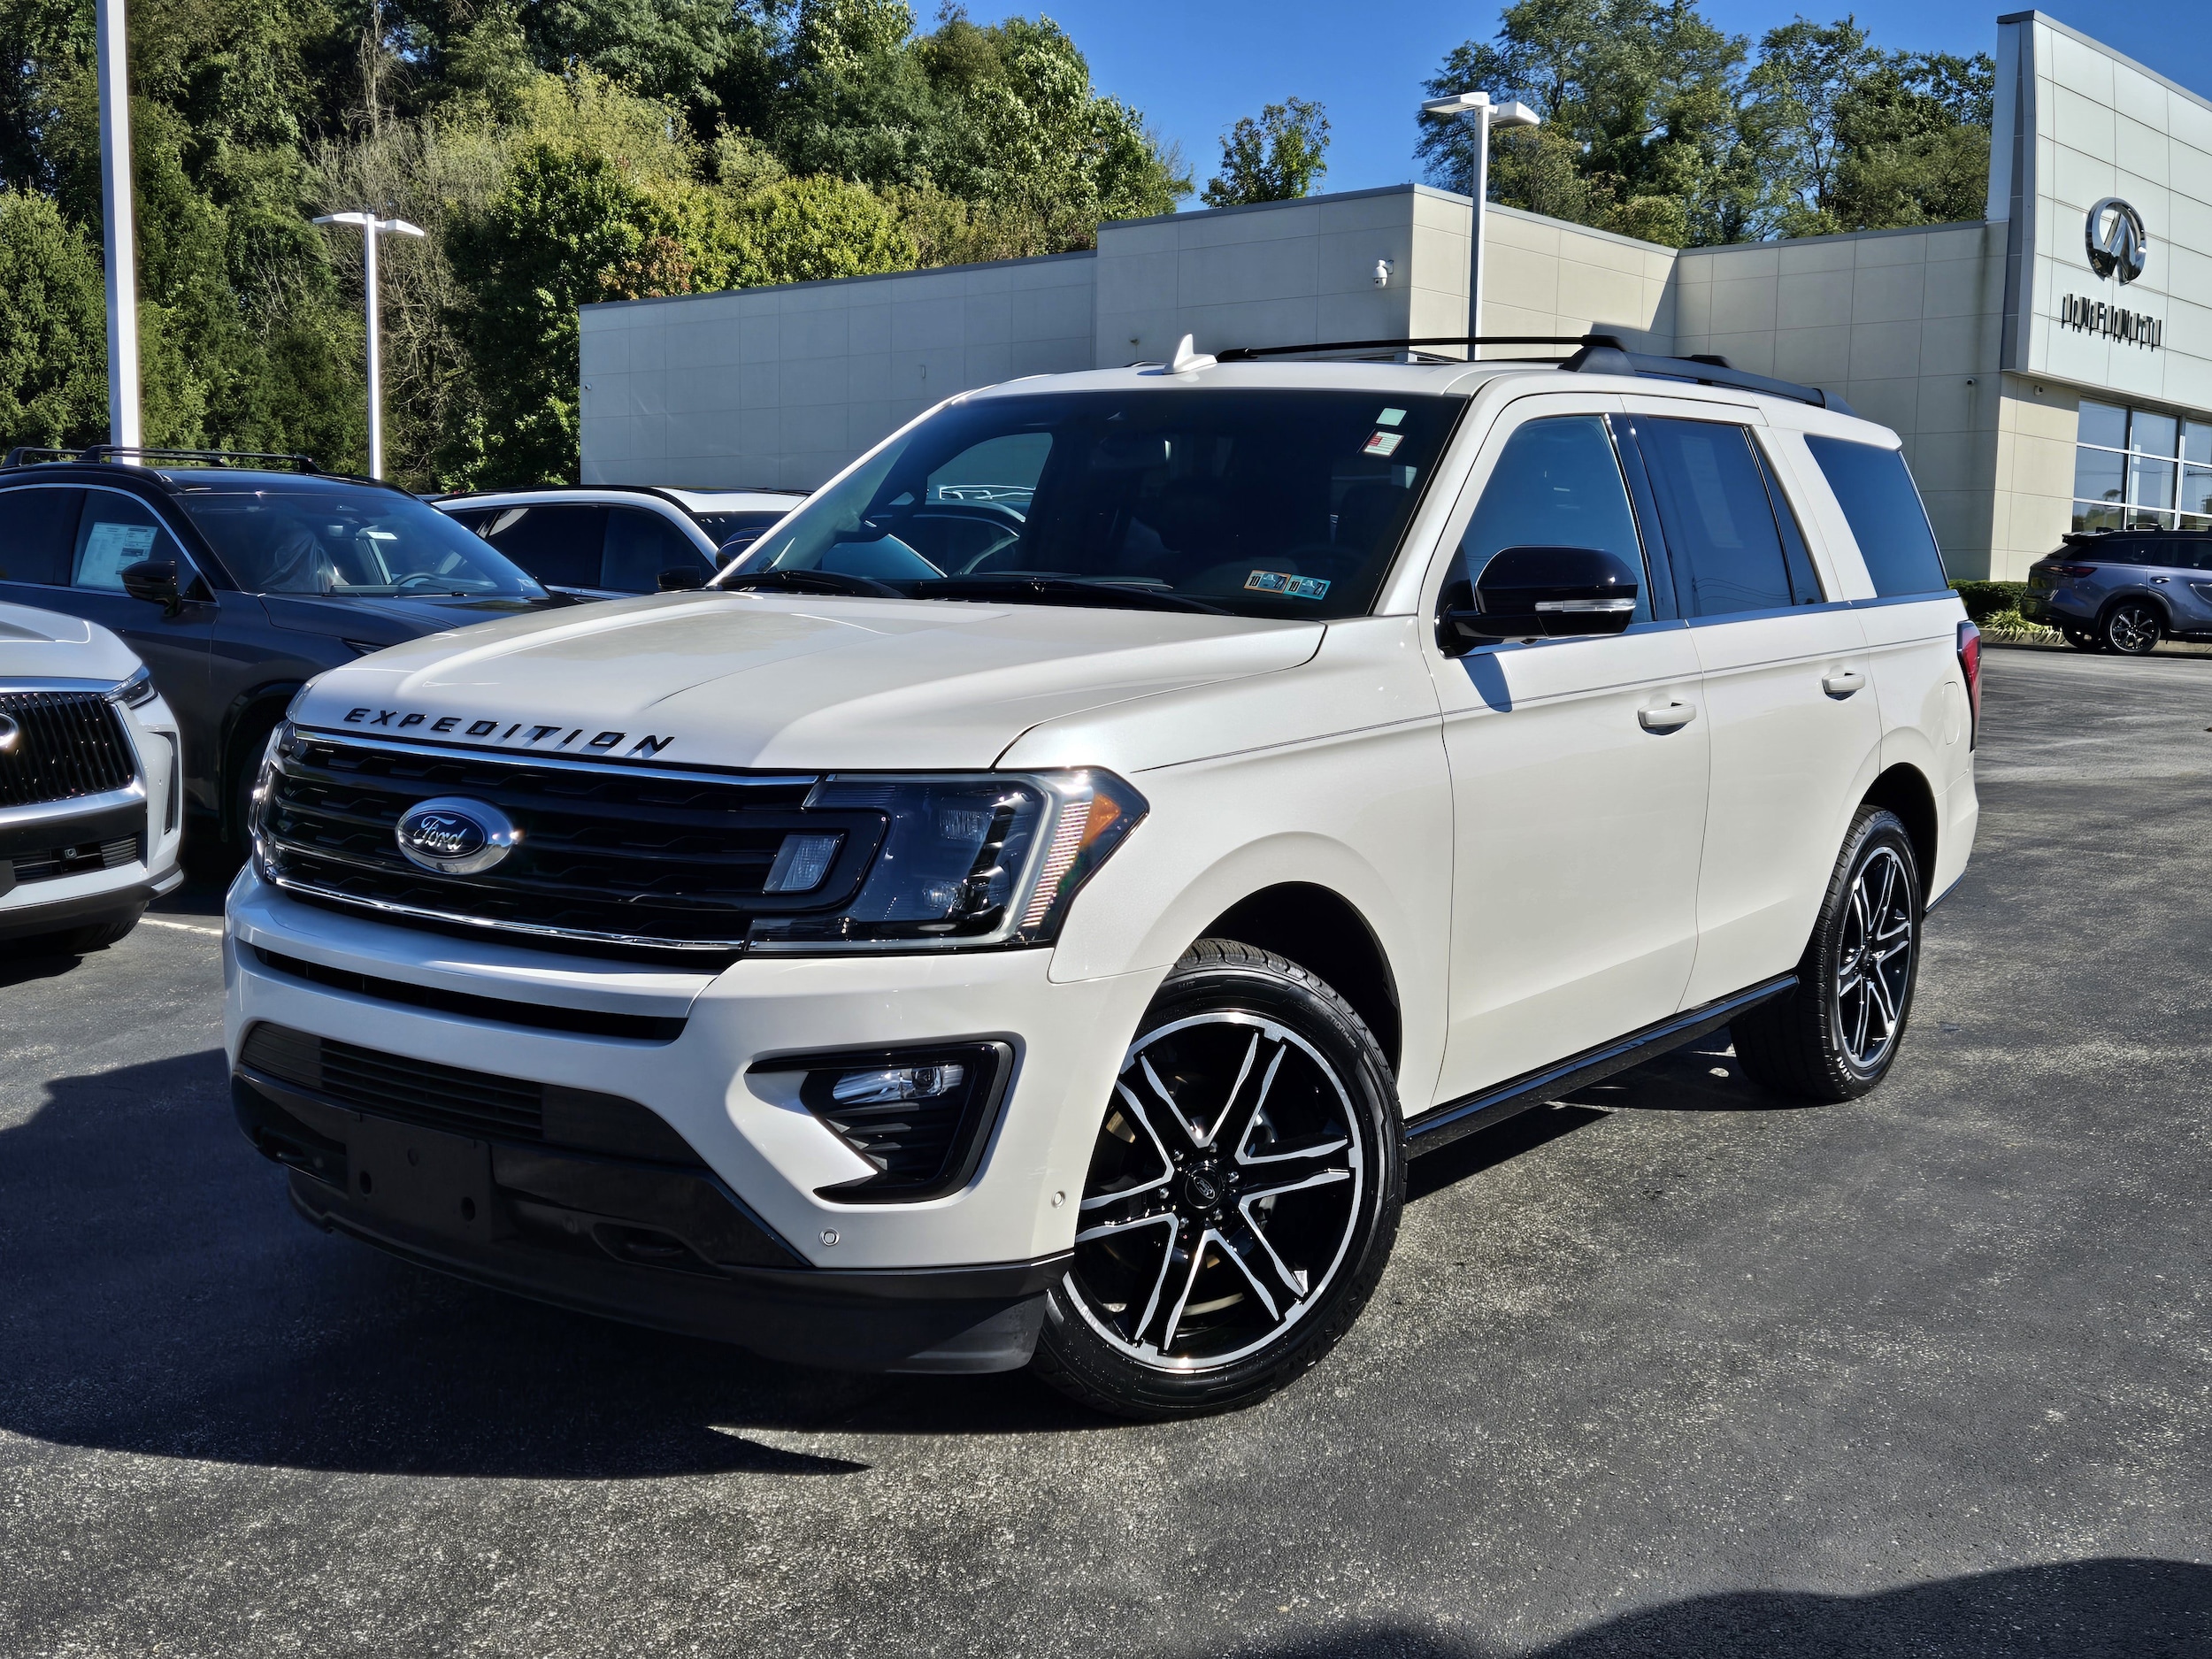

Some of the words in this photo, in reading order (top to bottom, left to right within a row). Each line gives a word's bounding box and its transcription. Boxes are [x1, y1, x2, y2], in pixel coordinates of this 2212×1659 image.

[2063, 294, 2162, 349] INFINITI
[343, 708, 675, 751] EXPEDITION
[414, 815, 468, 851] Ford
